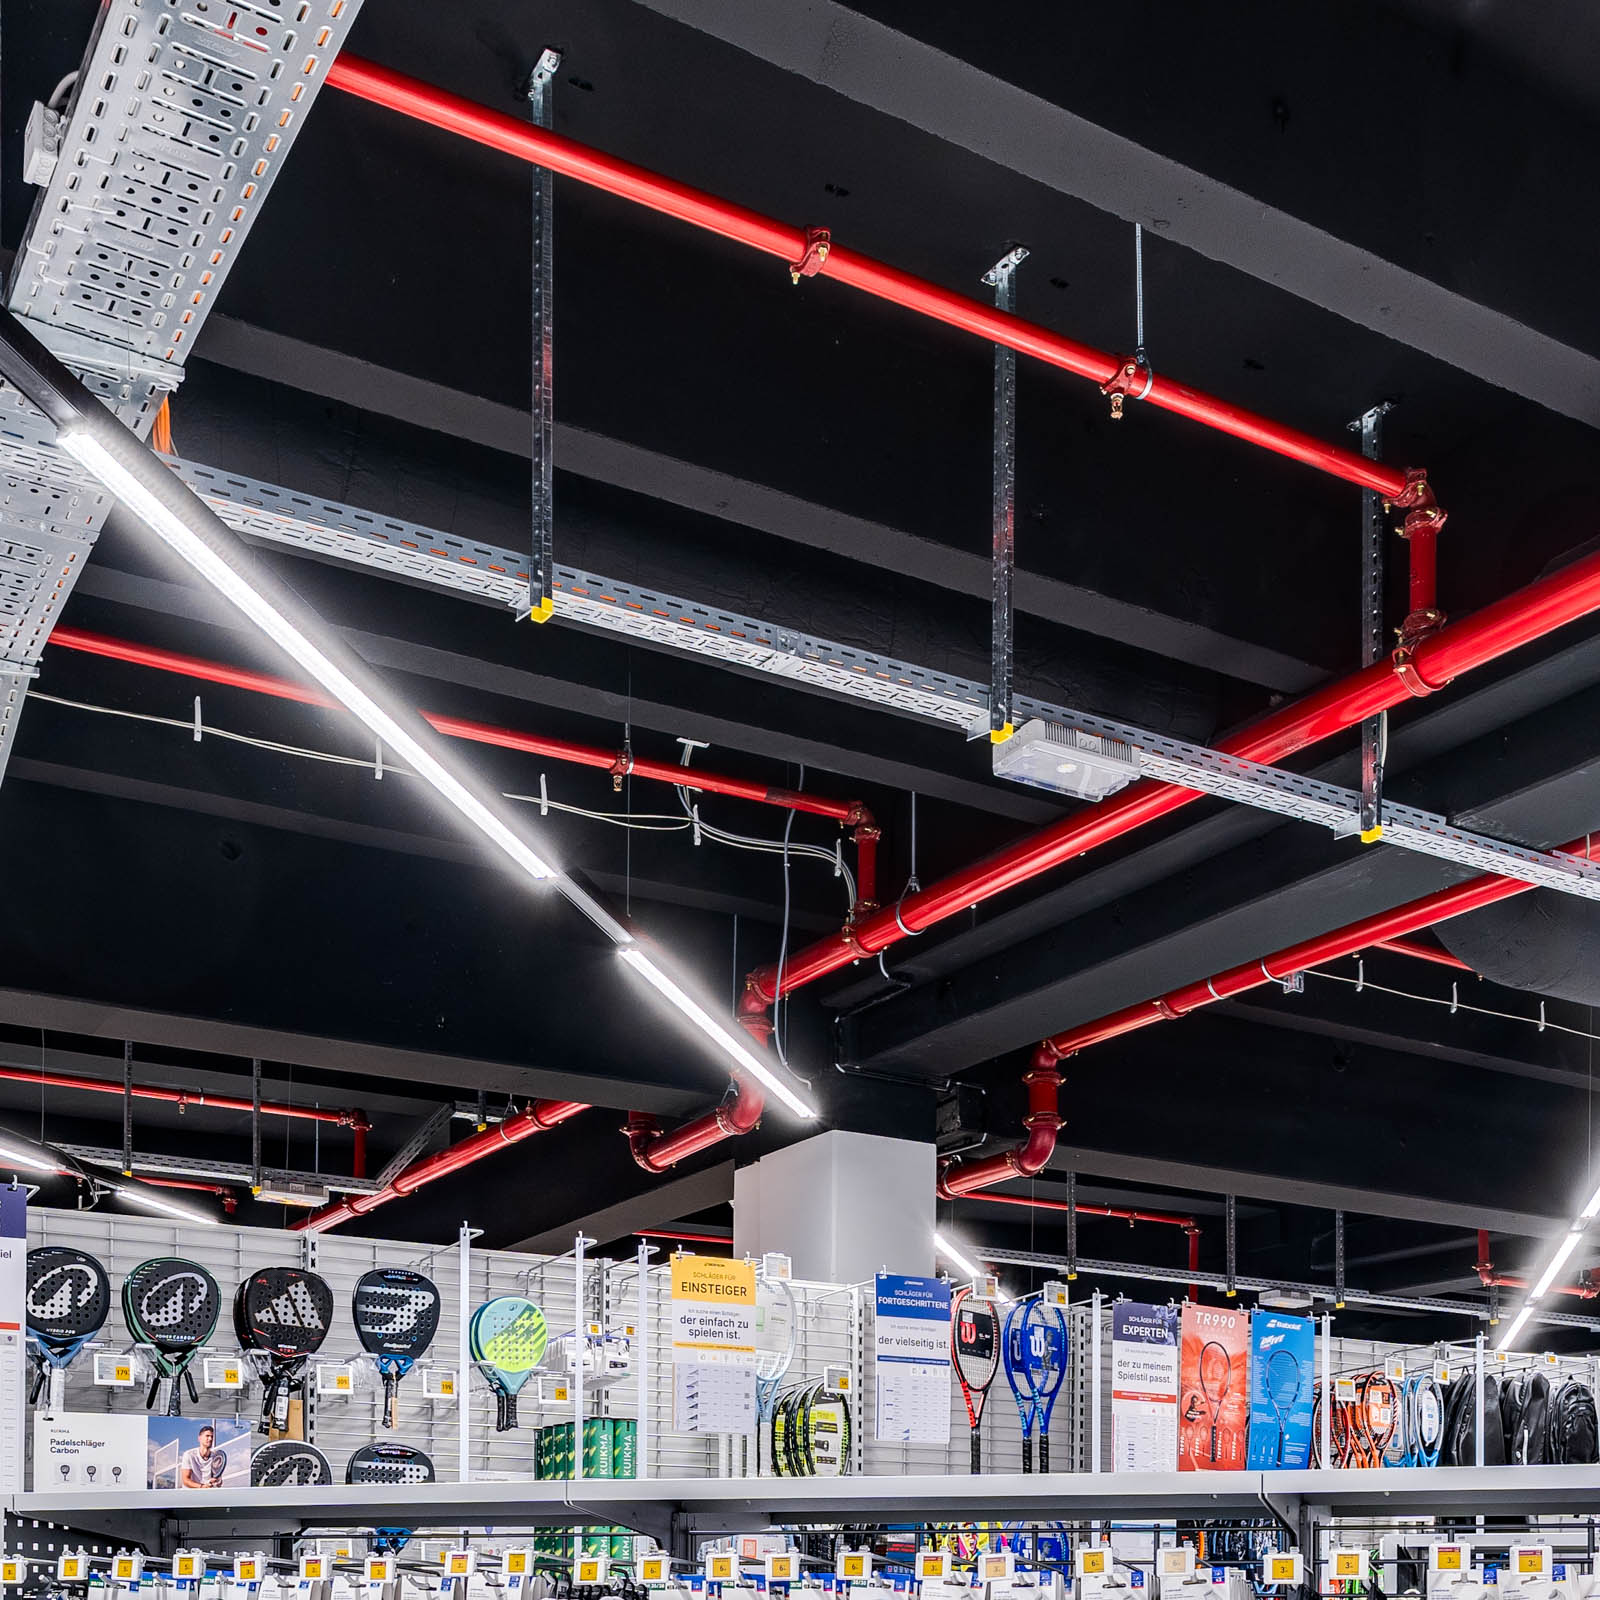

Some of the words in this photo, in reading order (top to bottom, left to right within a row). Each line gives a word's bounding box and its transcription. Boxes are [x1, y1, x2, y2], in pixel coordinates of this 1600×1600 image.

[681, 1281, 747, 1297] EINSTEIGER
[878, 1296, 949, 1310] FORTGESCHRITTENE
[680, 1315, 696, 1325] der
[699, 1316, 735, 1328] einfach
[738, 1320, 749, 1329] zu
[1195, 1311, 1236, 1329] TR990
[688, 1327, 724, 1339] spielen
[726, 1330, 741, 1340] ist.
[1122, 1325, 1169, 1338] EXPERTEN
[878, 1335, 893, 1345] der
[895, 1337, 934, 1349] vielseitig
[936, 1340, 949, 1350] ist.
[1117, 1359, 1130, 1368] der
[1131, 1361, 1141, 1369] zu
[1143, 1361, 1173, 1372] meinem
[1117, 1371, 1148, 1383] Spielstil
[1149, 1374, 1173, 1384] passt.
[50, 1438, 105, 1449] Padelschläger
[50, 1446, 79, 1454] Carbon
[599, 1433, 609, 1475] KUIKMA
[623, 1434, 633, 1477] KUIKMA
